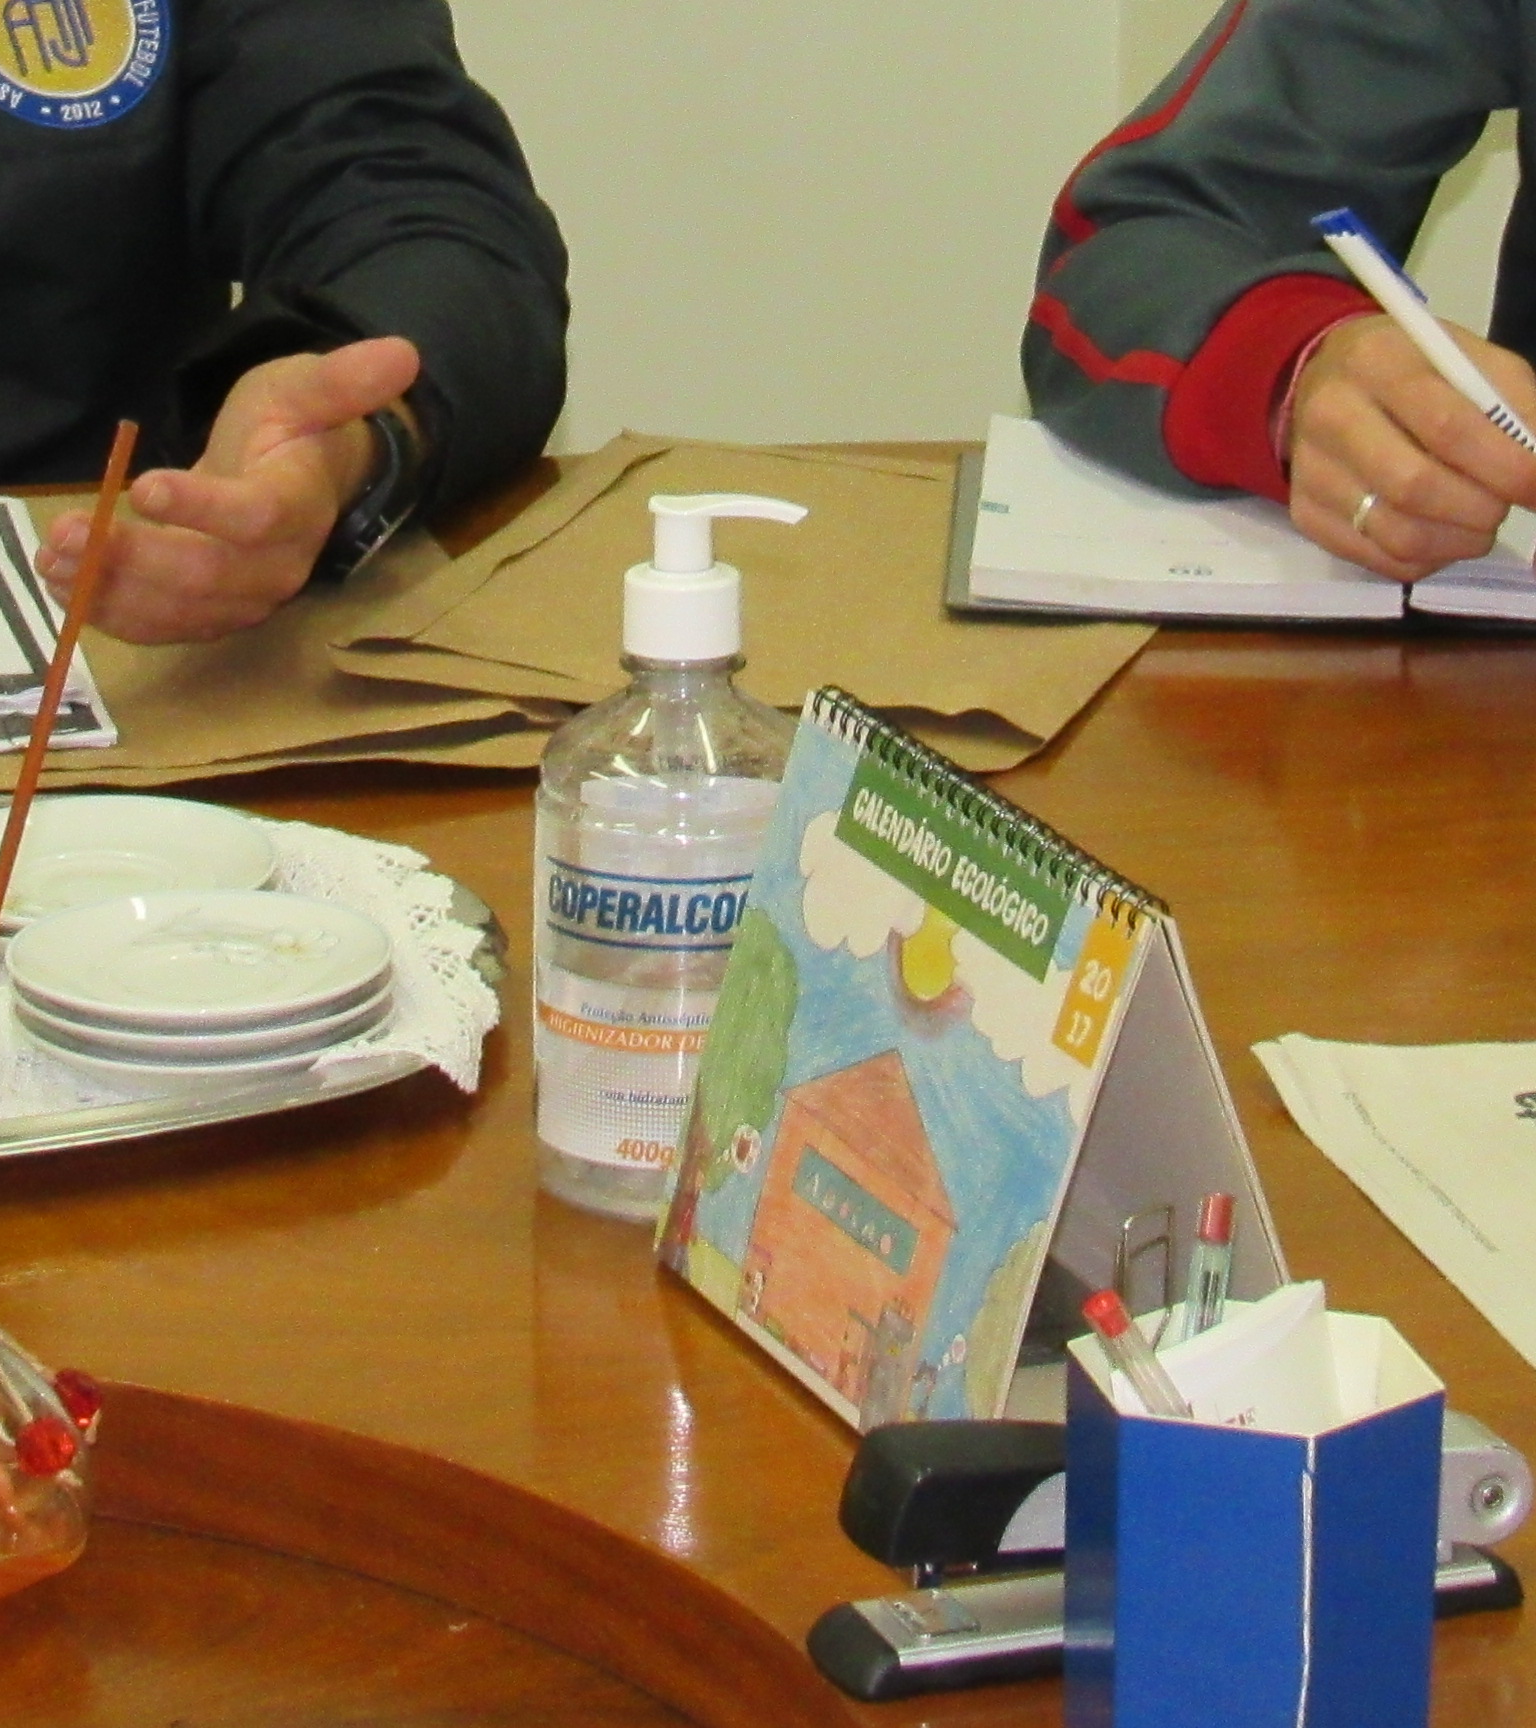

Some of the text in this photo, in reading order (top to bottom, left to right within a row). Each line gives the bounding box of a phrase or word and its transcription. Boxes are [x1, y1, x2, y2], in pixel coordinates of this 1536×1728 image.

[60, 102, 104, 120] 2012
[852, 787, 1049, 947] CALENDÁRIO ECOLÓGICO
[1078, 959, 1112, 1002] 20
[550, 1012, 672, 1051] HIGIENIZADOR
[1066, 1010, 1092, 1048] 17
